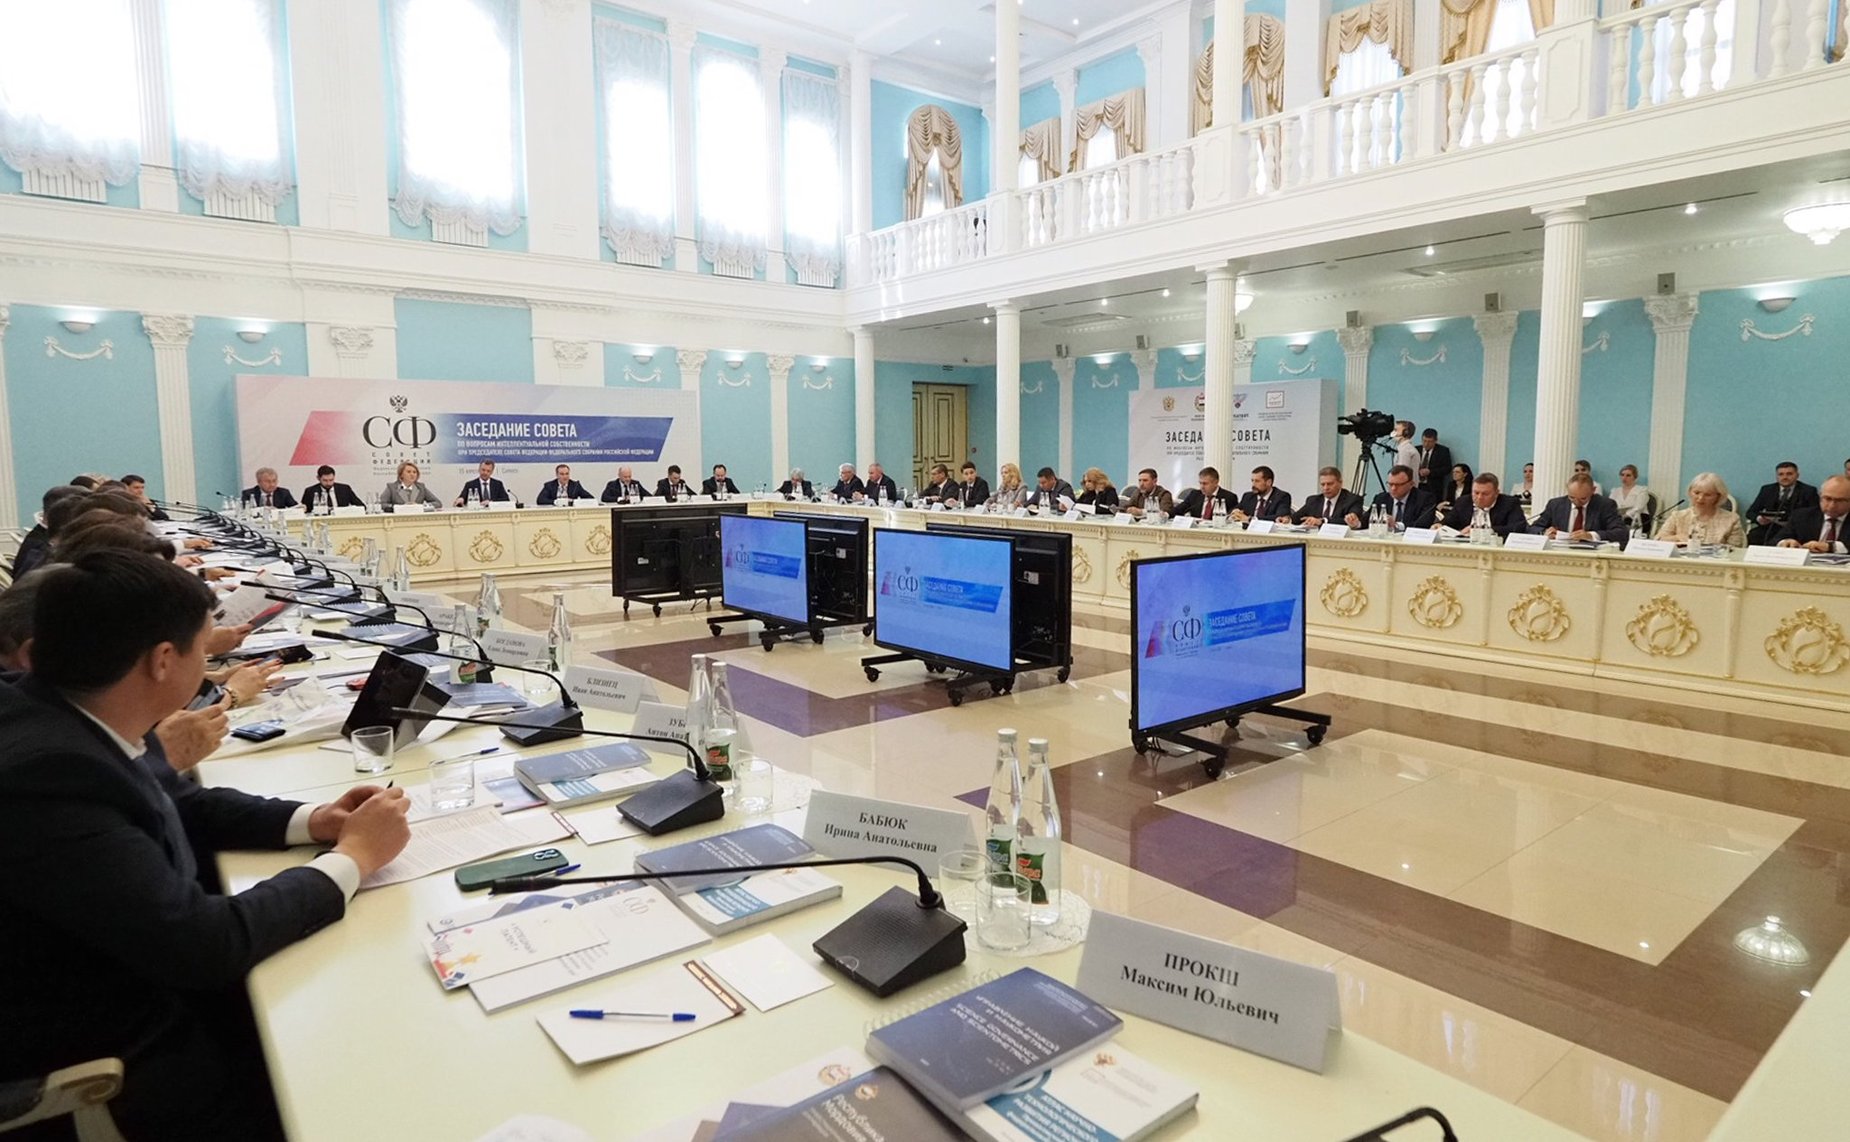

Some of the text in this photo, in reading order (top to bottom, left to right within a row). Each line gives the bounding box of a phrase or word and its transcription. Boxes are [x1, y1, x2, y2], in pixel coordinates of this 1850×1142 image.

[362, 415, 437, 449] СФ
[457, 422, 577, 439] ЗАСЕДАНИЕ СОВЕТА
[1165, 431, 1204, 444] ЗАСЕДА
[1172, 617, 1201, 642] СФ
[859, 812, 908, 830] БАБЮК
[824, 823, 938, 853] Ирина Анатольевна
[1163, 952, 1240, 987] ПРОКШ
[1120, 964, 1188, 998] Максим
[1193, 985, 1280, 1025] Юльевич
